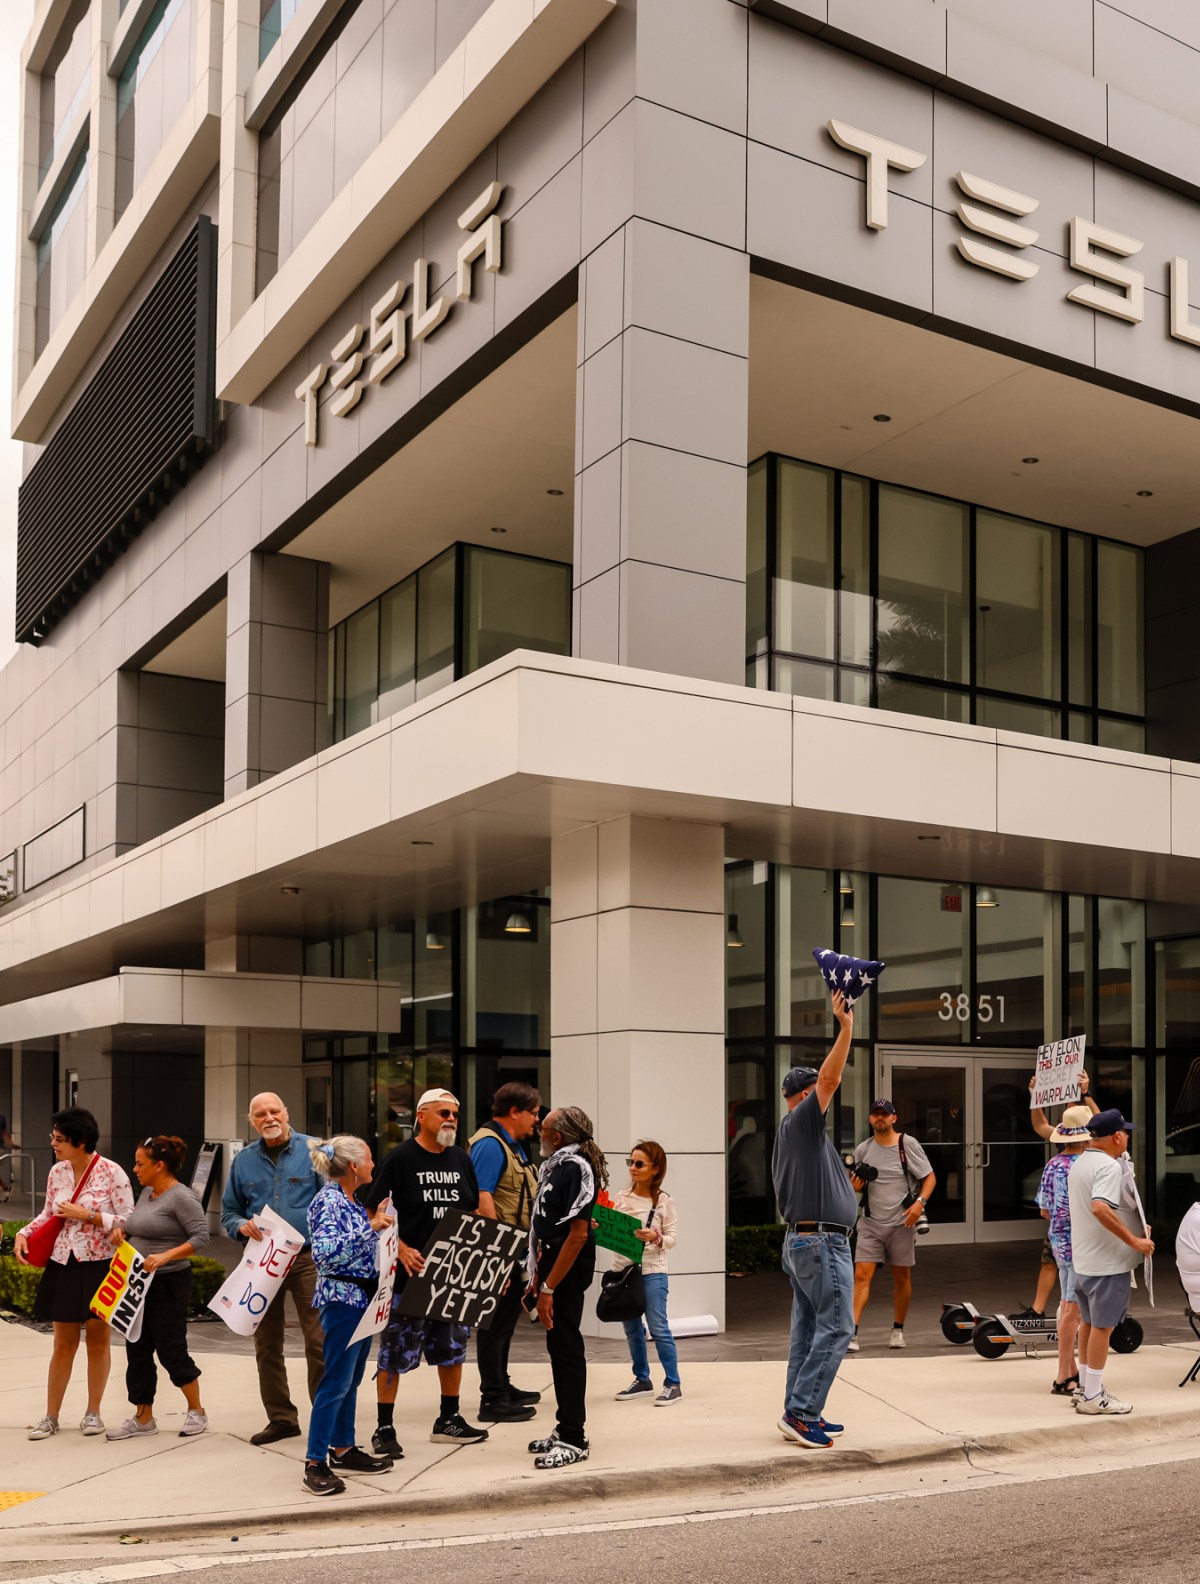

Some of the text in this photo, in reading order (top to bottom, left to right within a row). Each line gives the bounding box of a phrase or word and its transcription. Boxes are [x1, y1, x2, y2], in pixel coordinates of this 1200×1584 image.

[295, 181, 501, 447] TESLA
[938, 992, 1004, 1023] 3851
[1038, 1044, 1056, 1061] HEY
[1038, 1053, 1079, 1072] THIS IS OUR
[1038, 1065, 1074, 1086] SECRET
[416, 1171, 461, 1185] TRUMP
[423, 1189, 460, 1202] KILLS
[433, 1207, 448, 1220] M
[599, 1205, 632, 1227] ELON
[450, 1214, 528, 1257] IS IT
[97, 1252, 129, 1307] OUT
[425, 1283, 497, 1327] YET?
